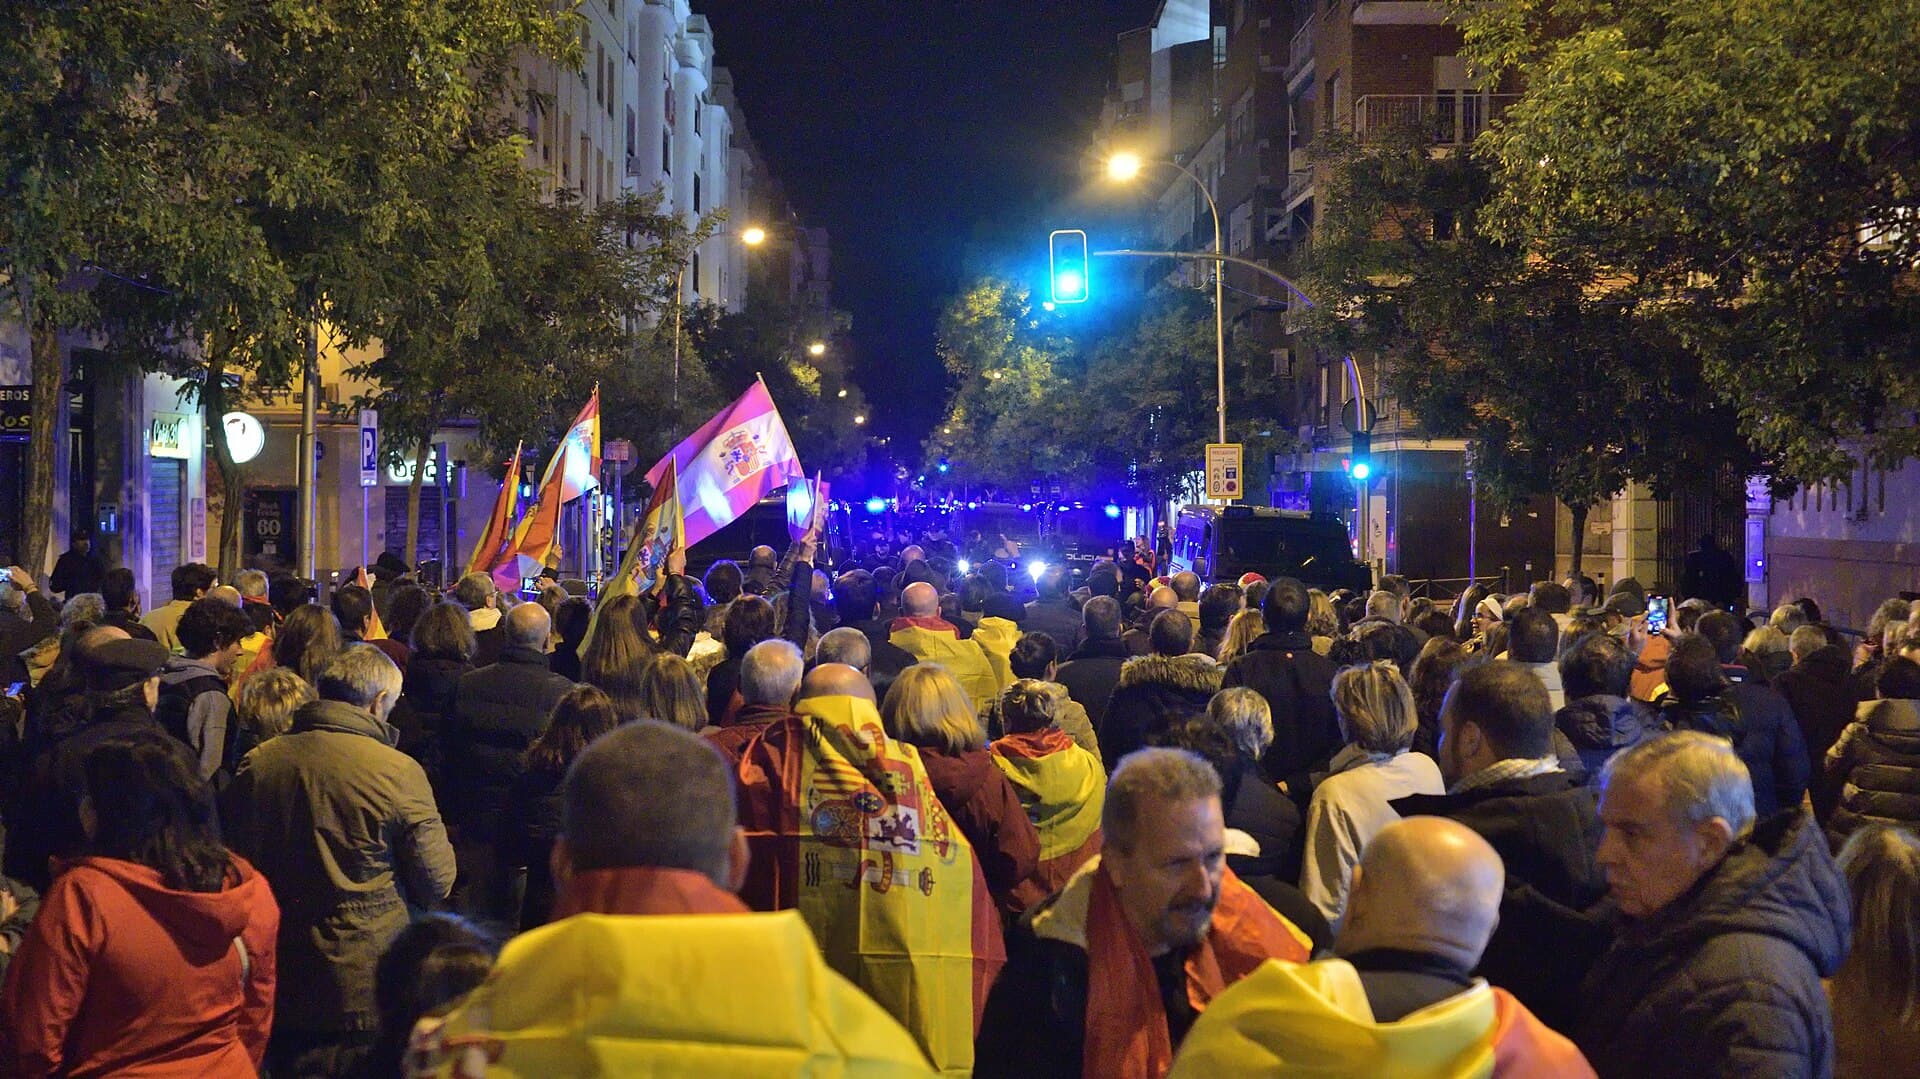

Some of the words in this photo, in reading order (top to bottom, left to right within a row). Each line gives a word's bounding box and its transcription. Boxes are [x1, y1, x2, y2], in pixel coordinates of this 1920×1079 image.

[363, 431, 373, 467] P
[257, 519, 281, 535] 60
[1065, 553, 1101, 561] OLICIA
